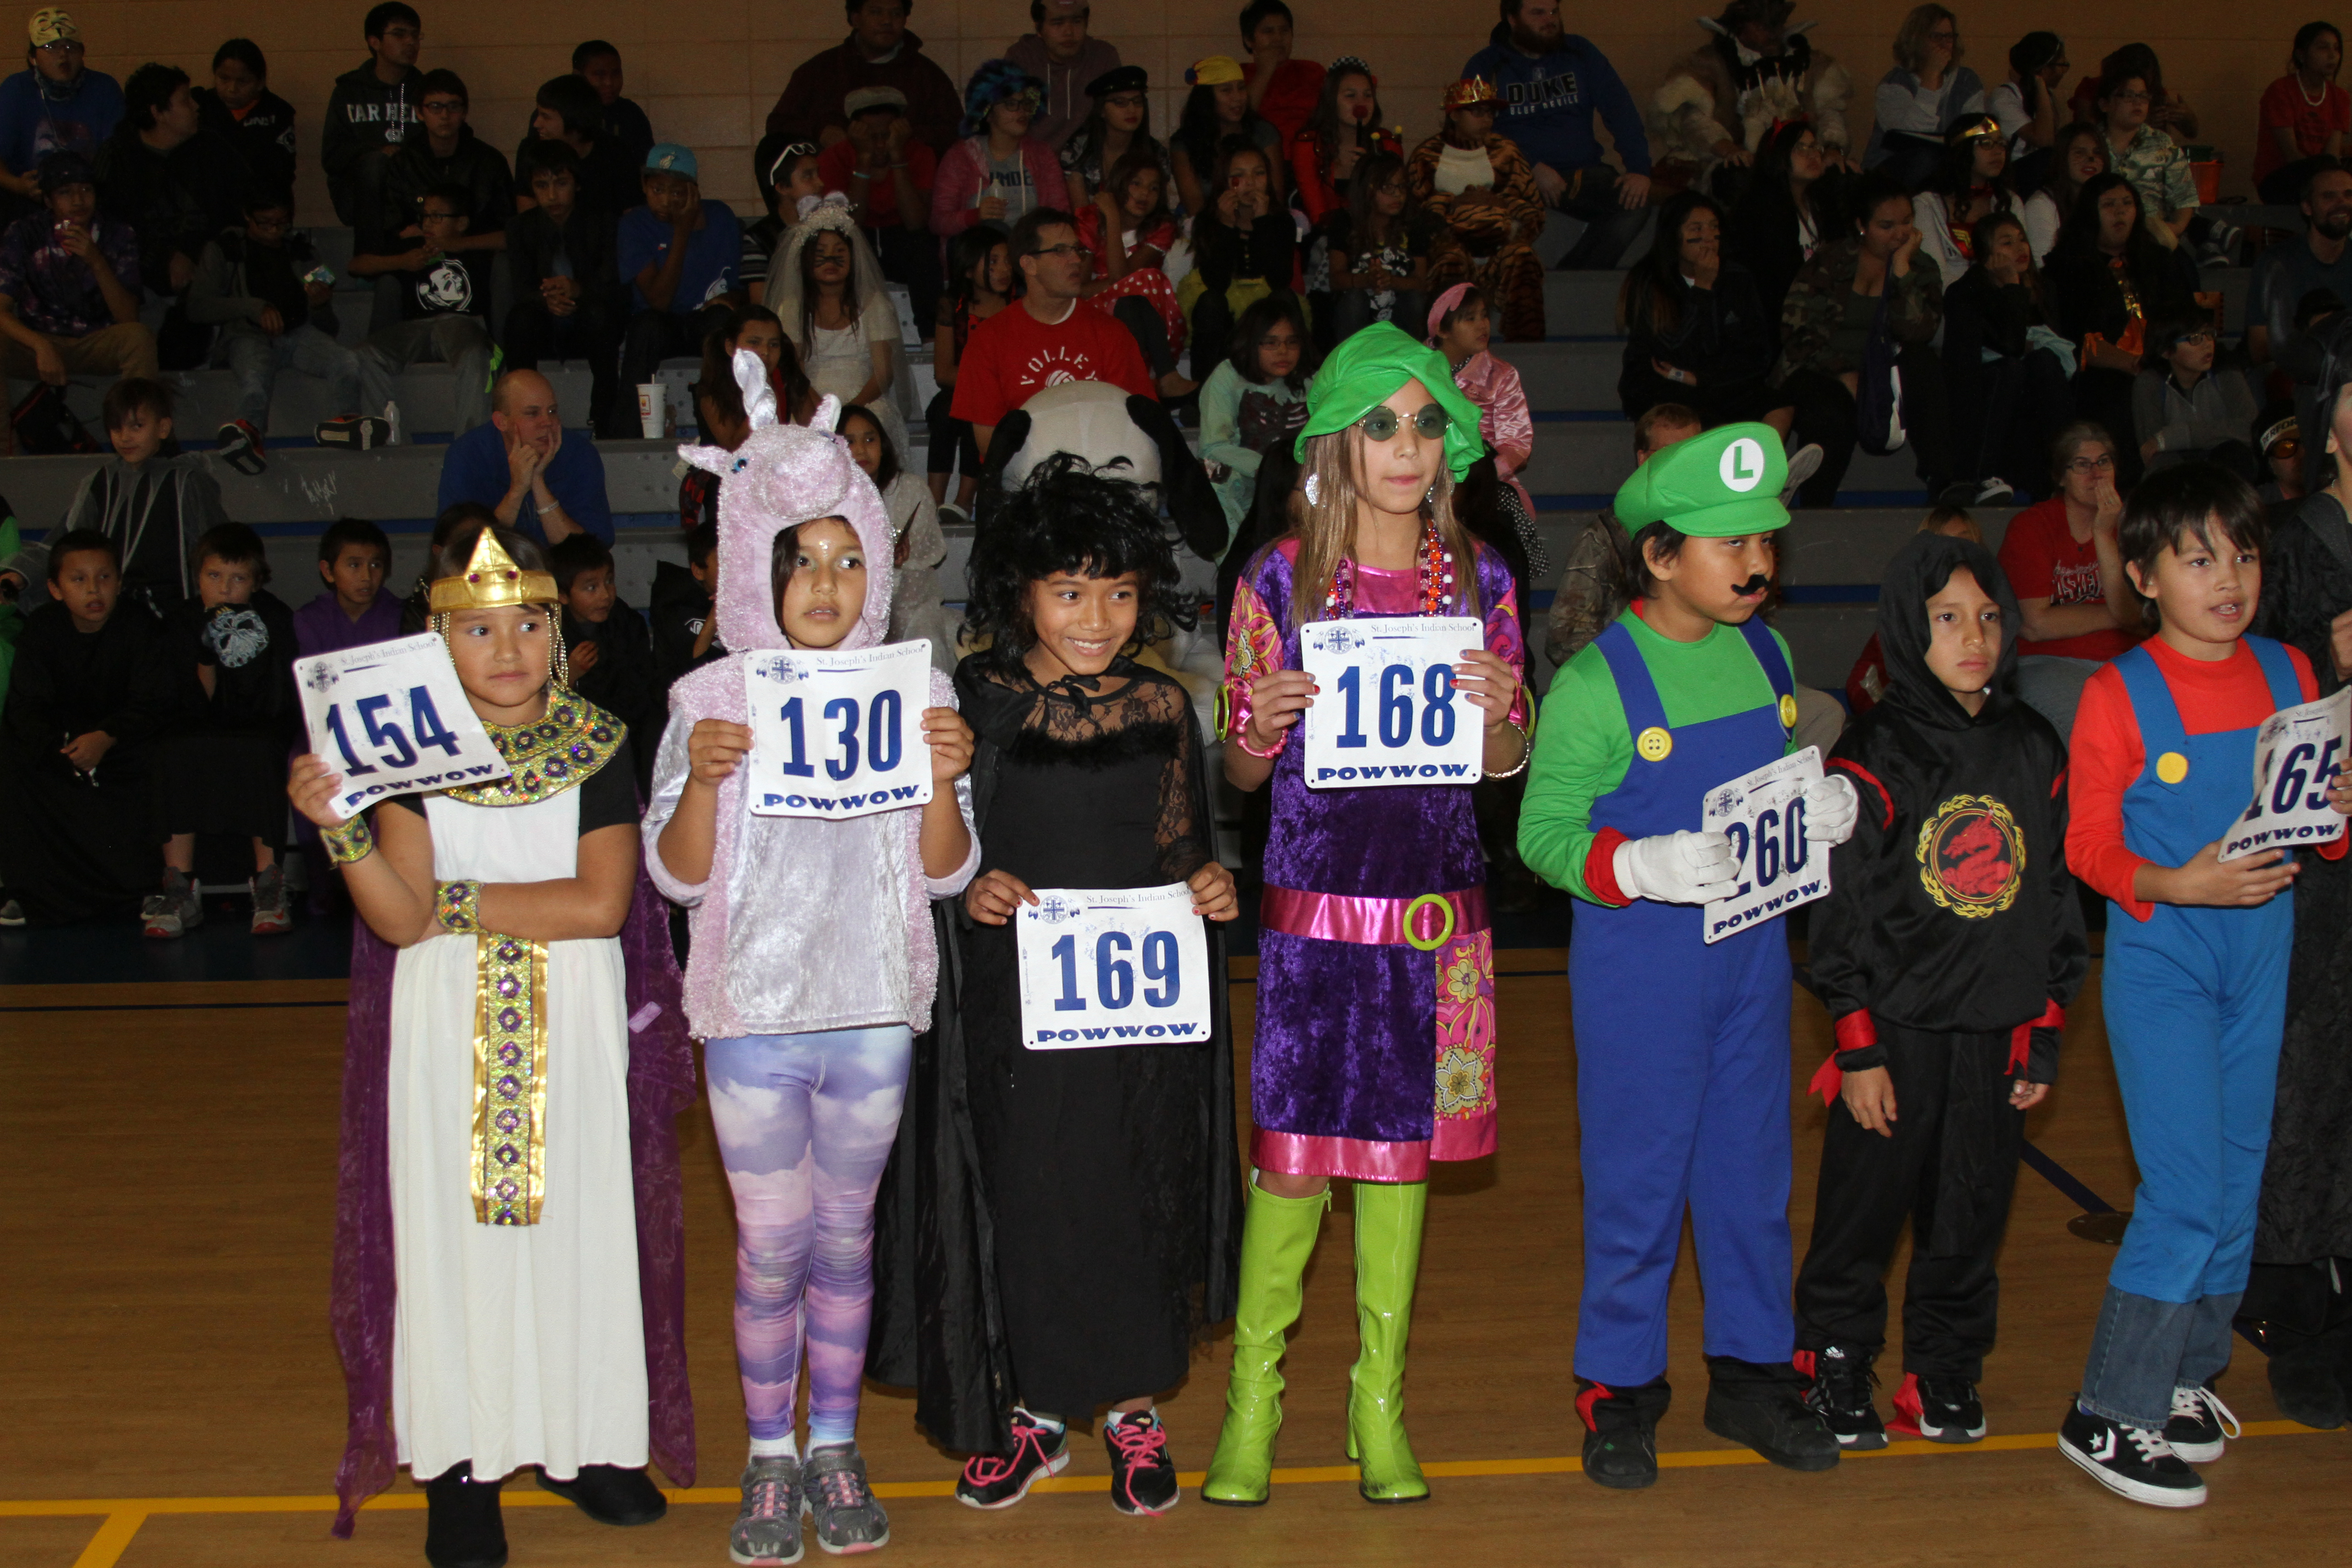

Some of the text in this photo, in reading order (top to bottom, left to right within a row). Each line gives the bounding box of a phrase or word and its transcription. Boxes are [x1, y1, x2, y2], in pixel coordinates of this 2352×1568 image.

[1507, 71, 1578, 106] DUKE
[347, 103, 381, 123] TAR
[1510, 94, 1579, 115] BLUE DEVILS
[1020, 346, 1099, 385] VOLLEY
[1733, 446, 1754, 480] L
[1371, 622, 1475, 633] St. Joseph's Indian School
[350, 651, 381, 665] Joseph's
[382, 647, 407, 657] Indian
[409, 640, 437, 652] School
[817, 647, 923, 667] St. Joseph's Indian School
[1336, 663, 1456, 748] 168
[326, 685, 462, 777] 154
[781, 689, 902, 781] 130
[1317, 764, 1469, 781] POWWOW
[1754, 768, 1776, 784] Joseph's
[1777, 762, 1796, 774] Indian
[1797, 755, 1815, 764] School
[345, 764, 494, 807] POWWOW
[764, 785, 920, 811] POWWOW
[1724, 796, 1808, 903] 260
[2227, 823, 2339, 854] POWWOW
[1098, 894, 1136, 904] Joseph's
[1138, 893, 1165, 902] Indian
[1167, 888, 1191, 899] School
[1713, 879, 1821, 935] POWWOW
[1052, 931, 1180, 1011] 169
[1037, 1022, 1198, 1042] POWWOW
